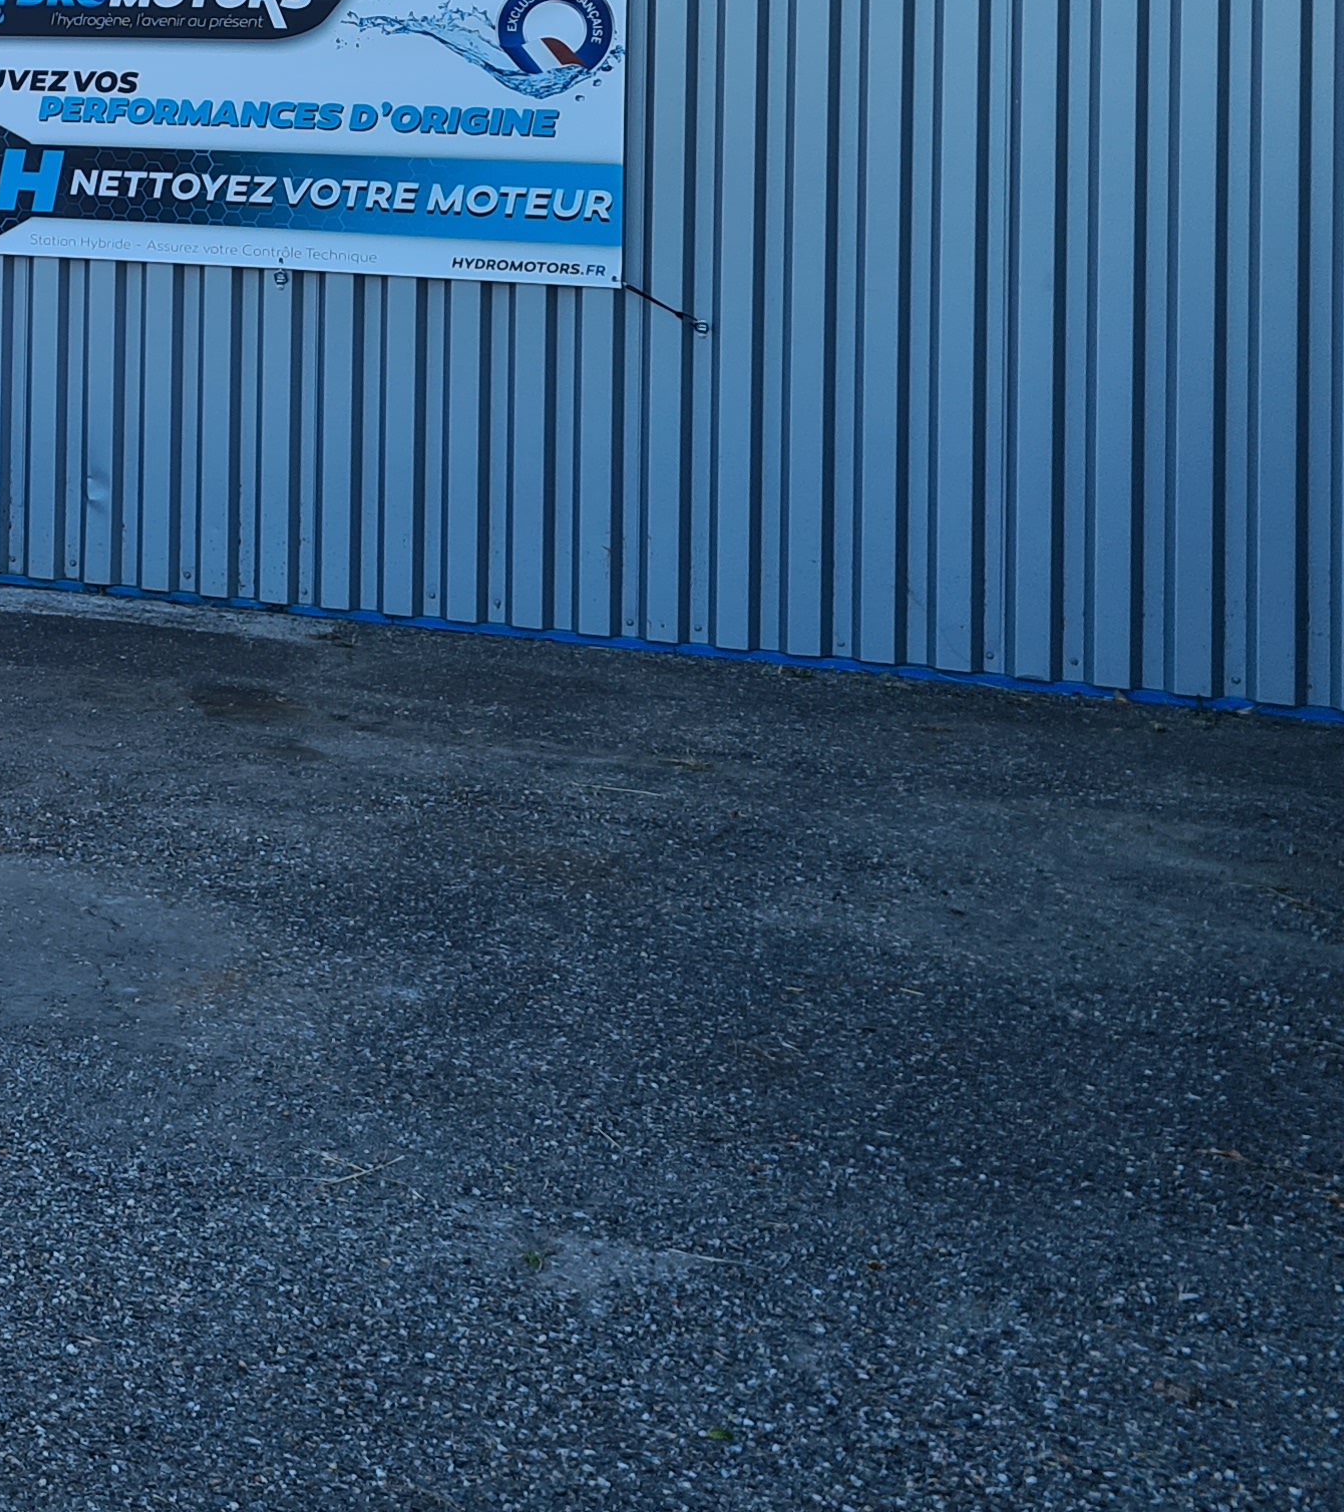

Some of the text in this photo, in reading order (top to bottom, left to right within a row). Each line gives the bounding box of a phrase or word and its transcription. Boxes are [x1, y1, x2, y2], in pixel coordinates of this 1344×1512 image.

[136, 12, 186, 28] l'avenir
[189, 16, 207, 27] au
[208, 14, 264, 30] présent
[73, 71, 139, 93] VOS
[38, 95, 560, 137] PERFORMANCES D'ORIGINE
[70, 169, 285, 206] NETTOYEZ
[283, 176, 419, 213] VOTRE
[426, 183, 613, 223] MOTEUR
[30, 233, 77, 246] Station
[80, 236, 132, 251] Hybride
[147, 239, 200, 254] Assurez
[202, 245, 239, 256] votre
[242, 245, 302, 259] Contrôle
[306, 247, 378, 264] Technique
[452, 257, 606, 277] HYDROMOTORS.FR
